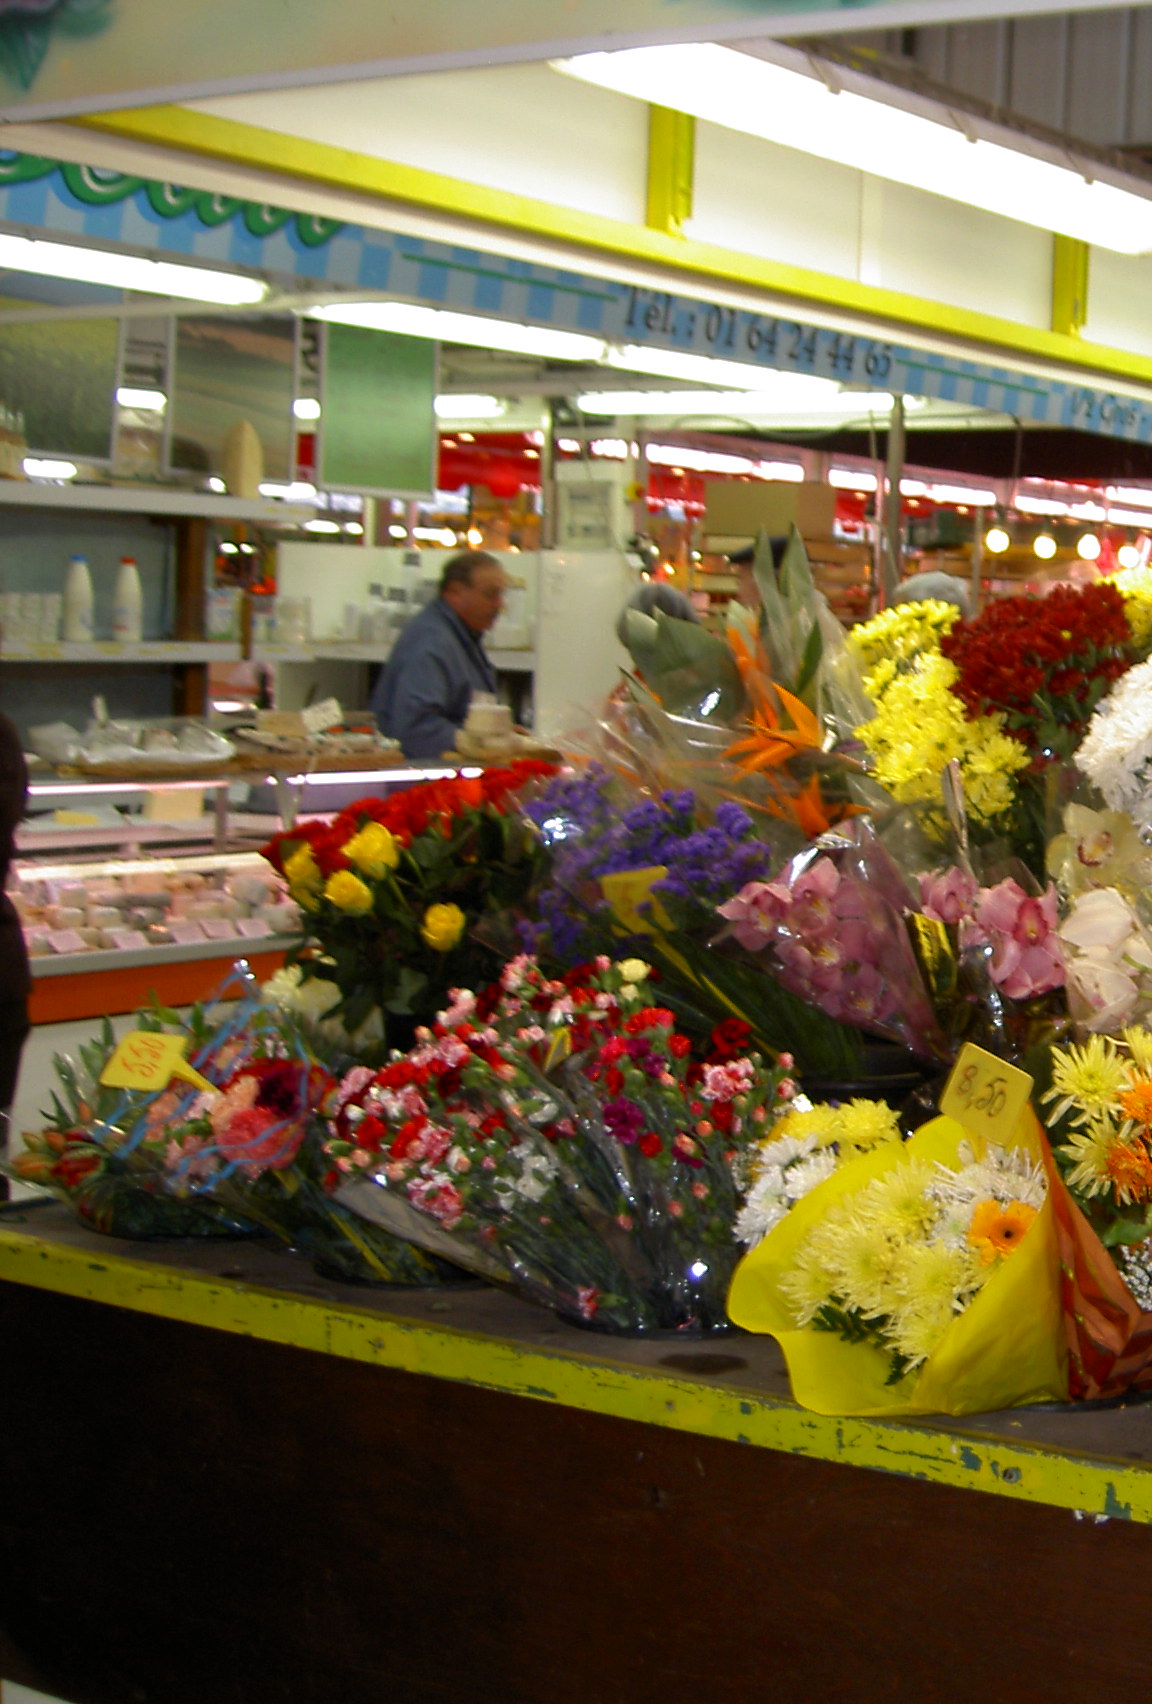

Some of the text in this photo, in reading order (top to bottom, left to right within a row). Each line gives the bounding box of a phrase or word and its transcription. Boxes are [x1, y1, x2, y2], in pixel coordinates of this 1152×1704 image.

[705, 304, 737, 346] 01
[747, 317, 780, 355] 64
[788, 323, 819, 364] 24
[828, 331, 856, 372] 44
[864, 340, 892, 378] 65
[956, 1064, 1009, 1118] 8,50
